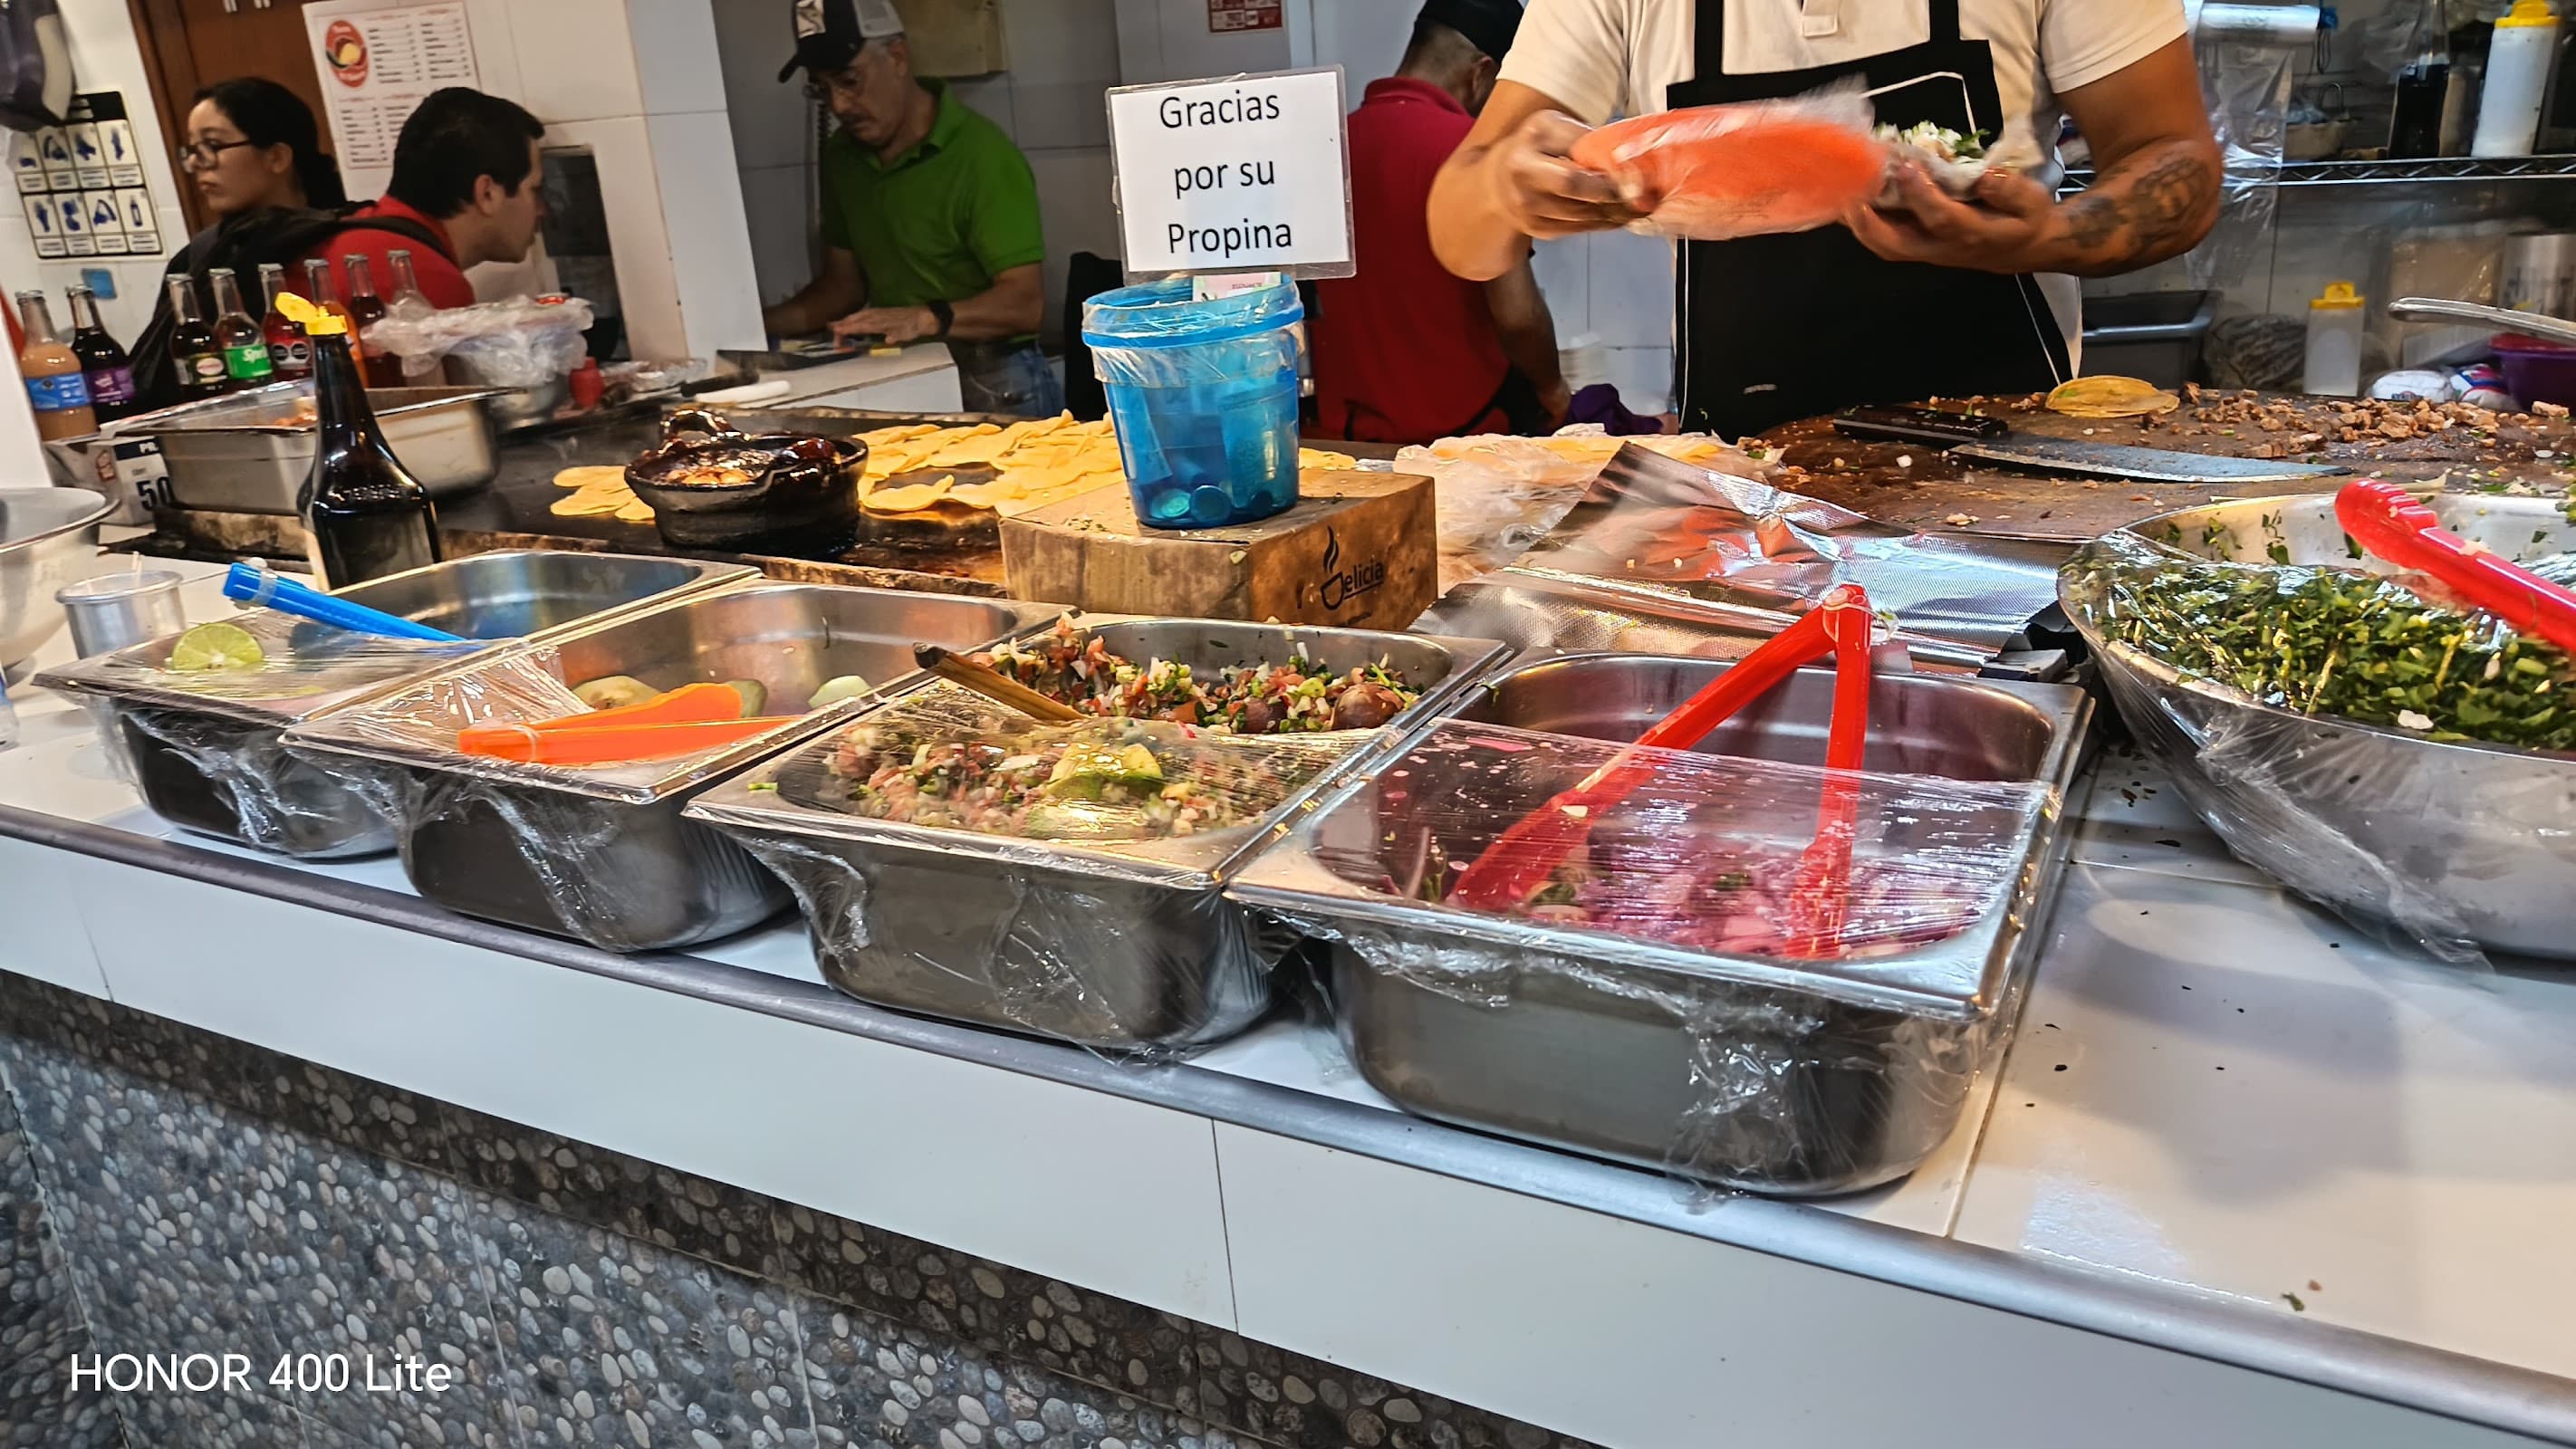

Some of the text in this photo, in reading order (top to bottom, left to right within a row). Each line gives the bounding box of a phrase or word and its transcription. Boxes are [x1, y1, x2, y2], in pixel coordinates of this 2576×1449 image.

[1159, 89, 1280, 129] Gracias
[1174, 160, 1274, 200] por su
[1168, 217, 1292, 259] Propina
